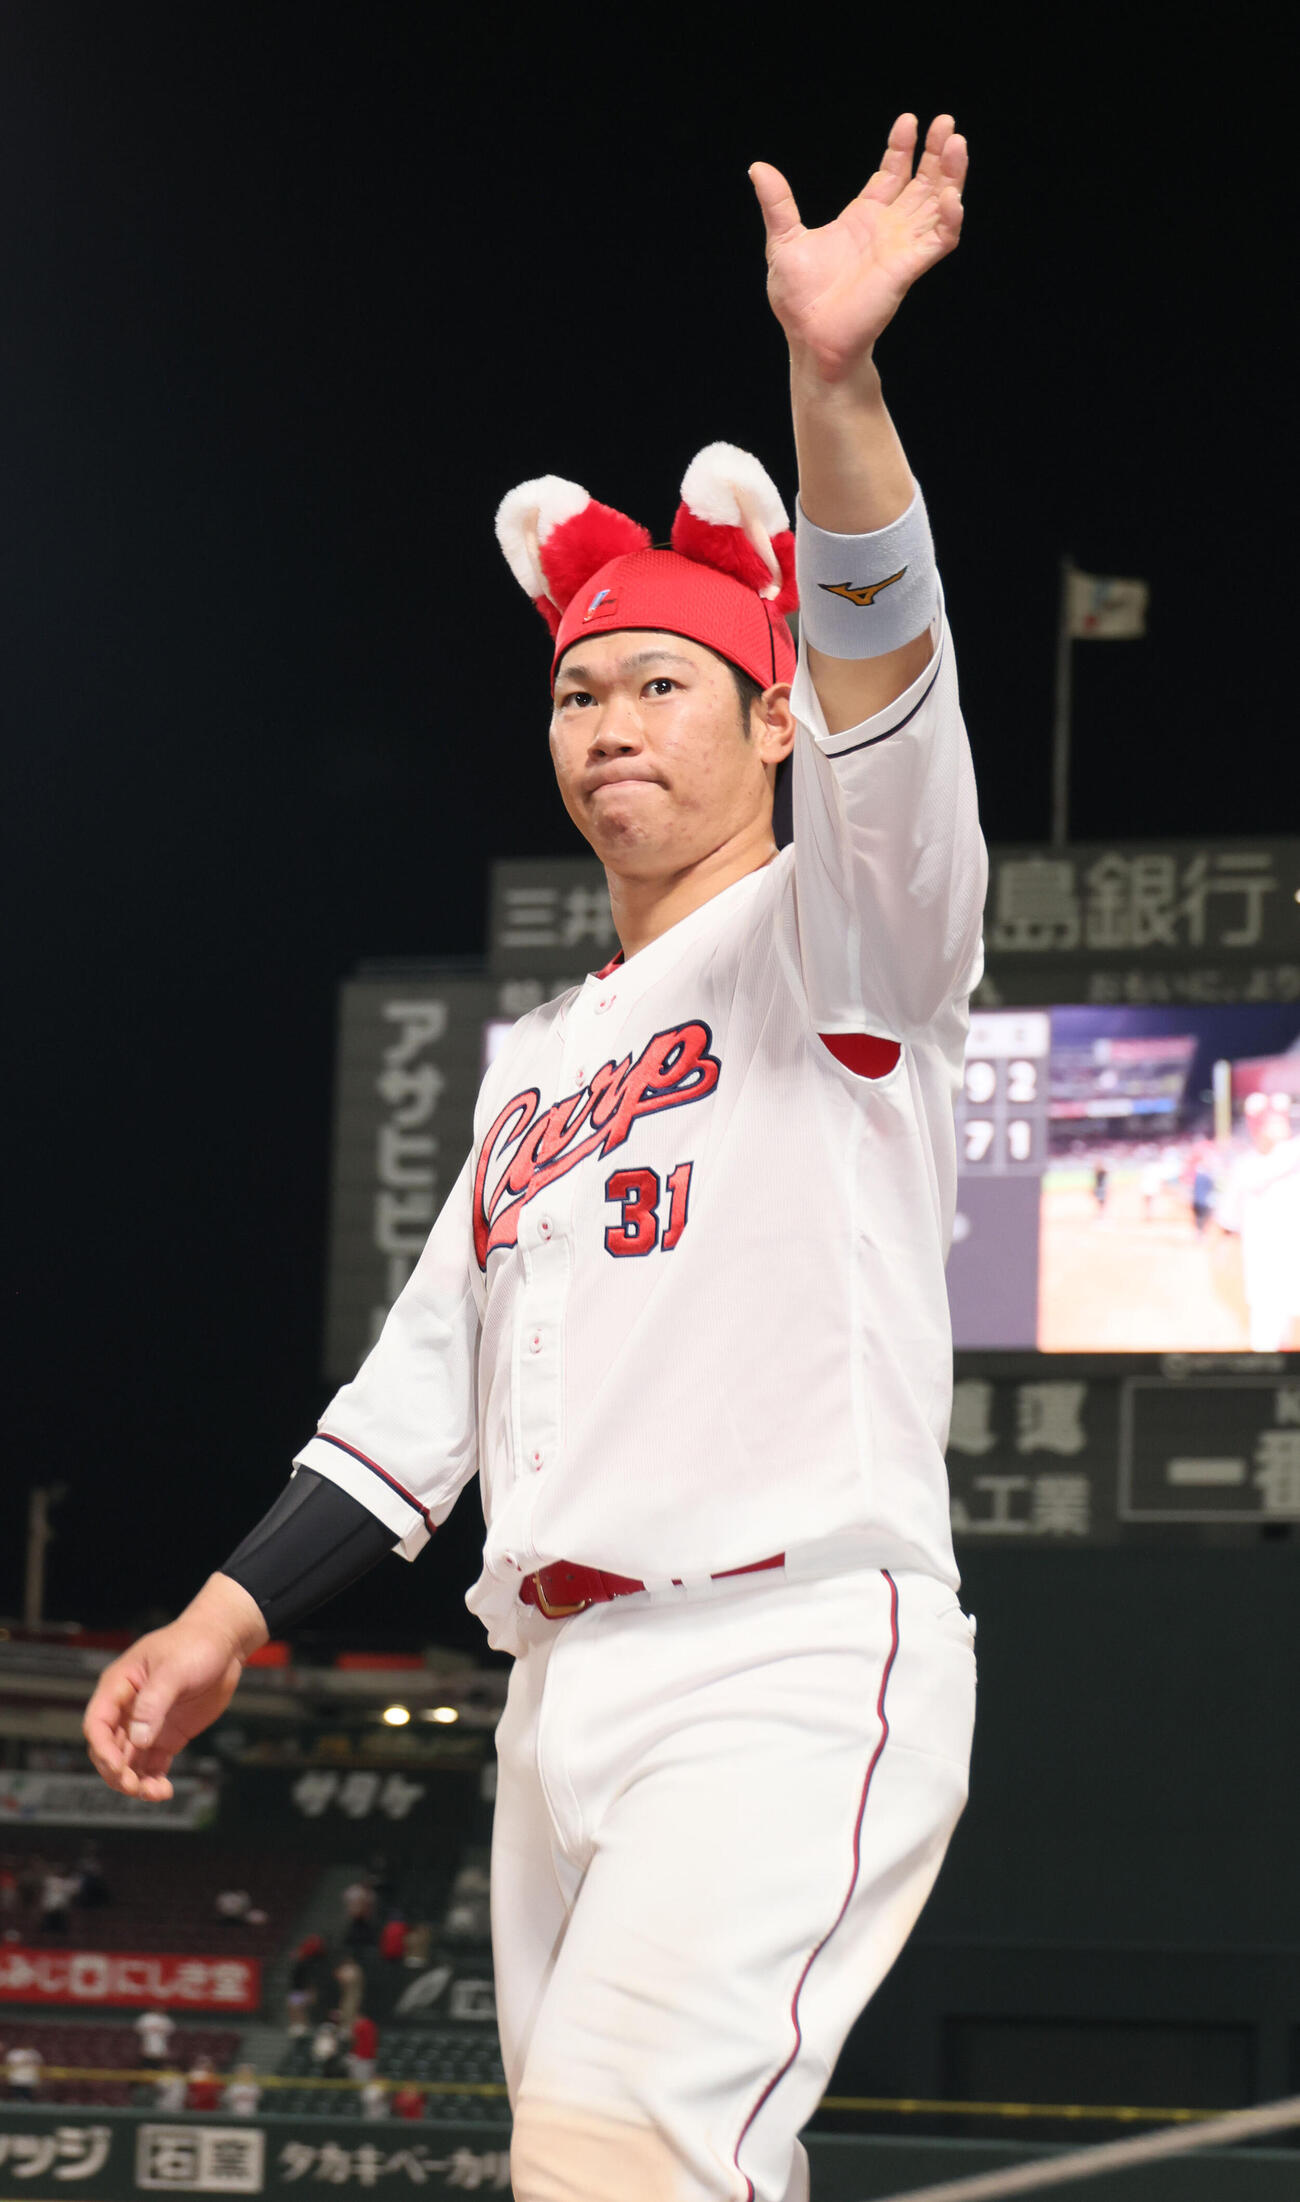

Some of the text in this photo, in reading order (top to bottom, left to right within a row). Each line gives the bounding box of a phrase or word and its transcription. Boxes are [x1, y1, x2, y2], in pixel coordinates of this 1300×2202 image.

[472, 1018, 723, 1273] Carp
[603, 1160, 695, 1258] 31
[0, 2125, 112, 2181] ッジ
